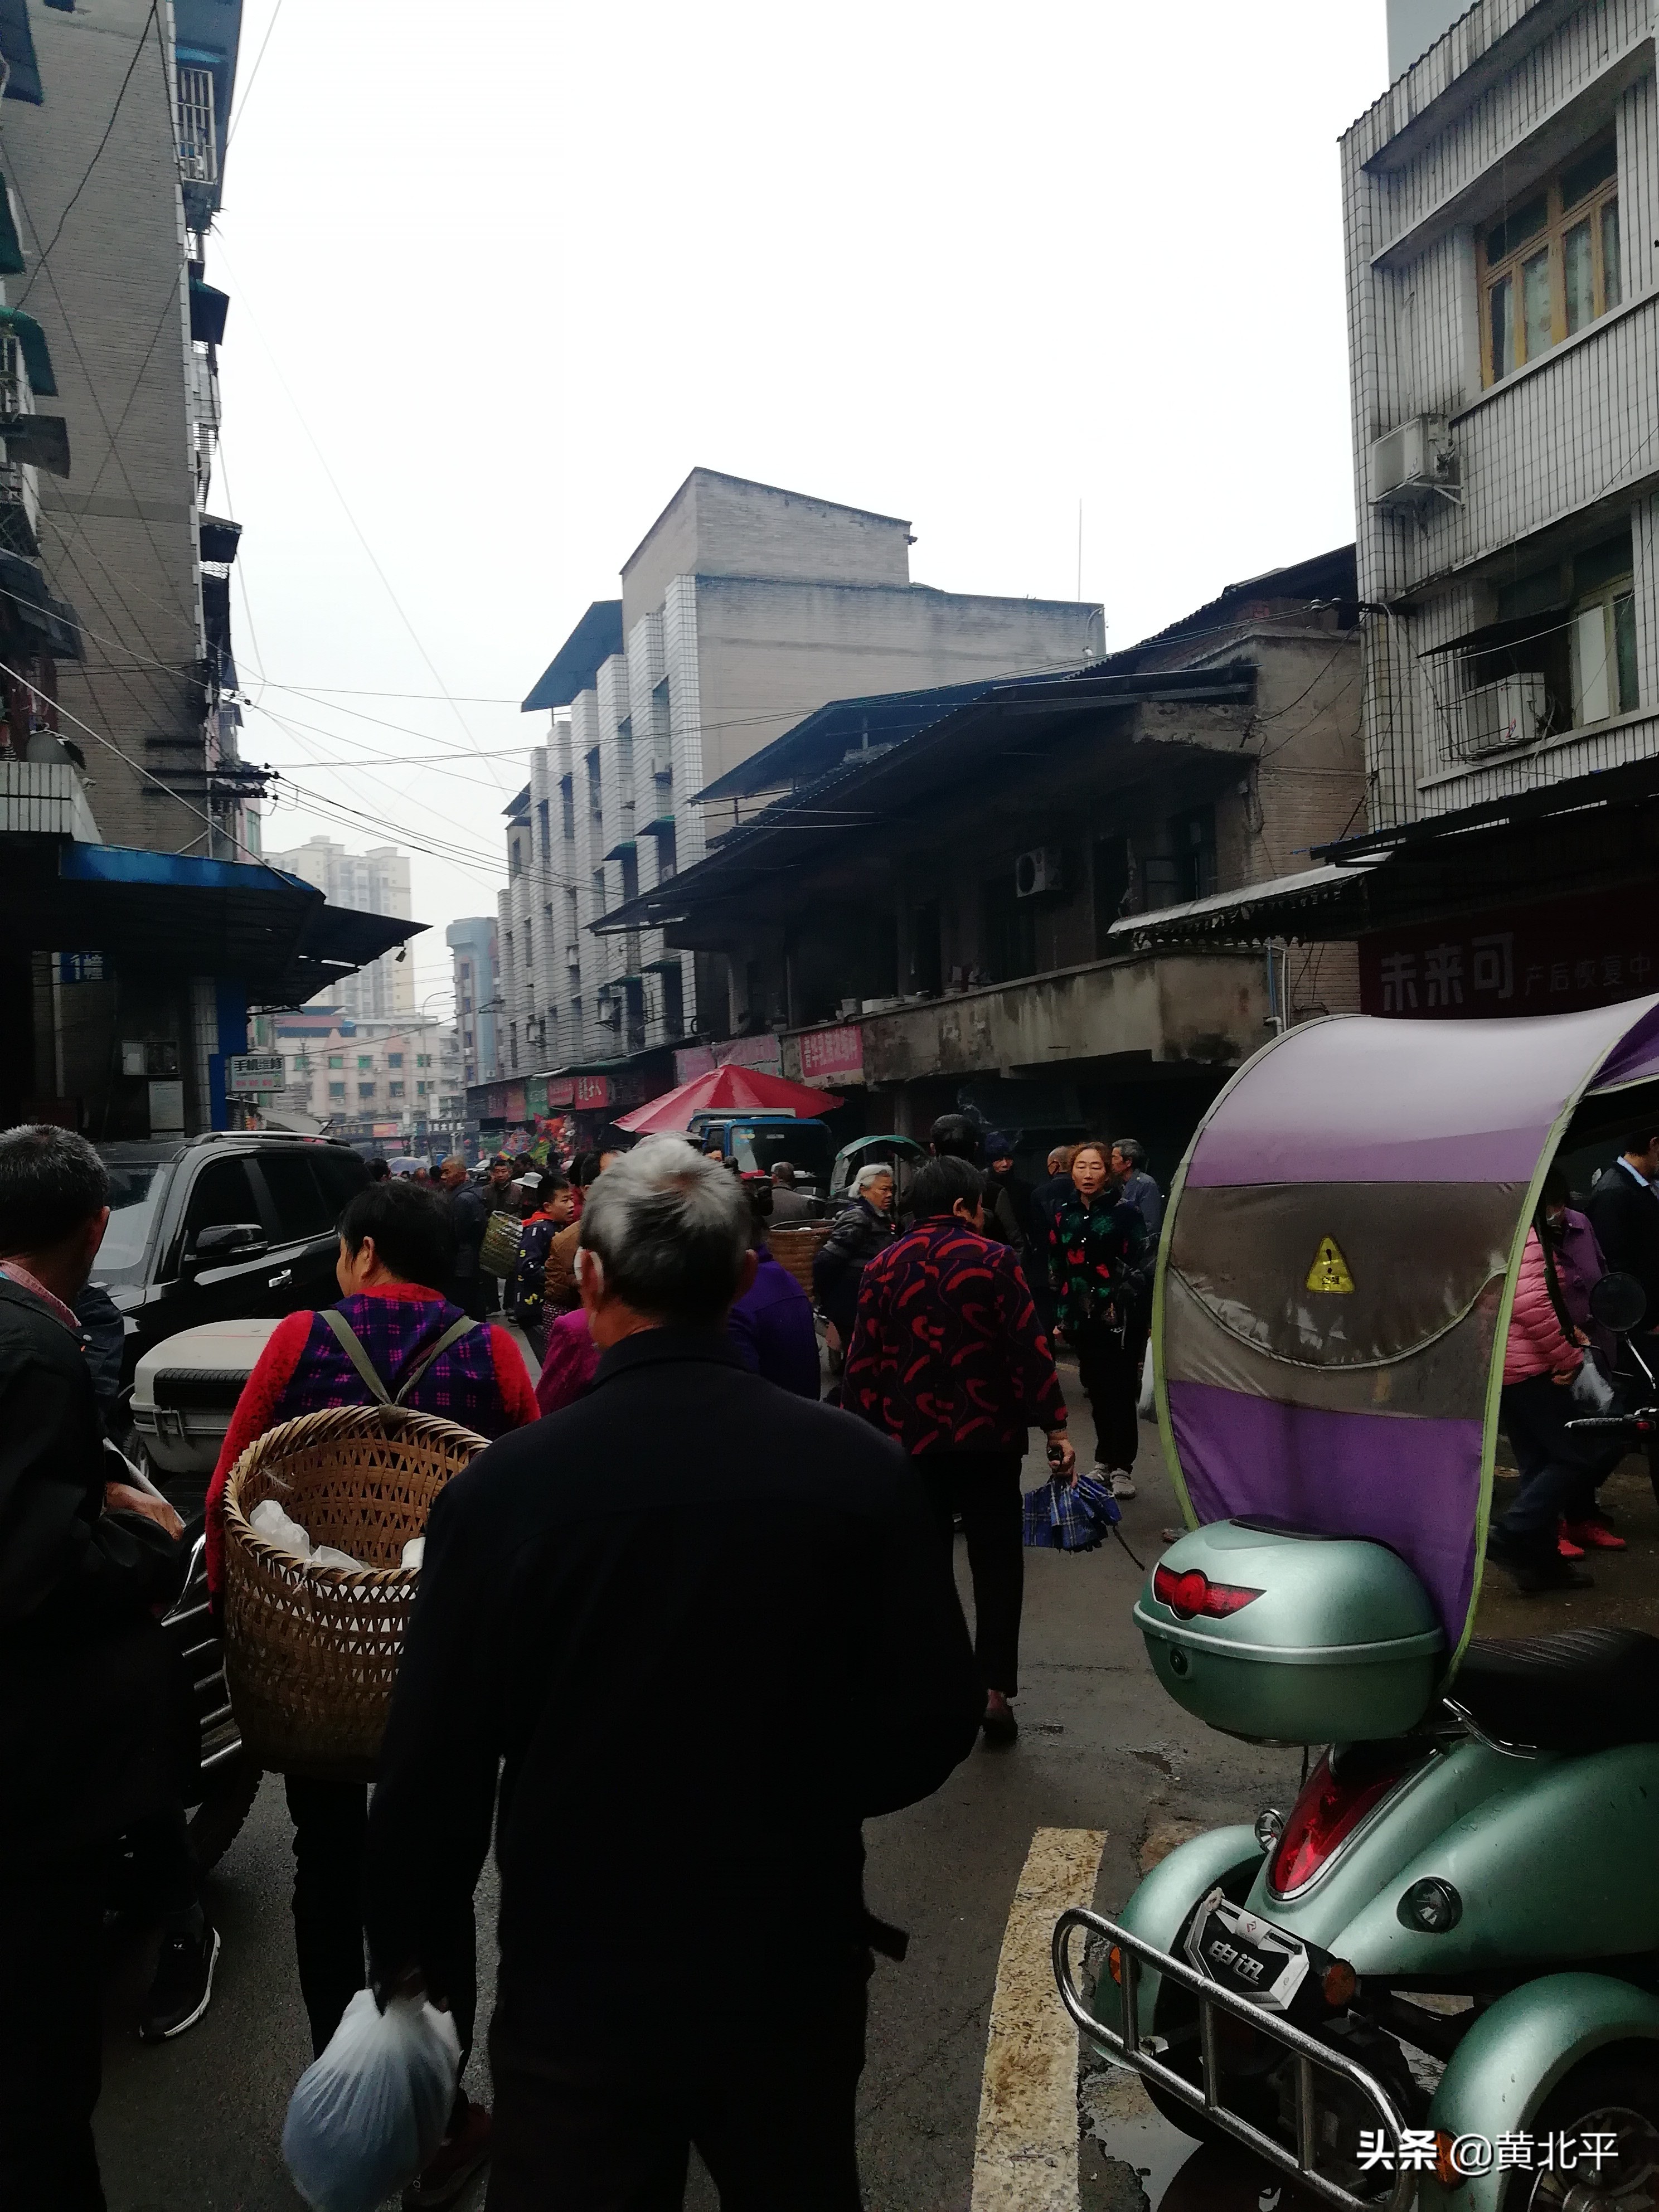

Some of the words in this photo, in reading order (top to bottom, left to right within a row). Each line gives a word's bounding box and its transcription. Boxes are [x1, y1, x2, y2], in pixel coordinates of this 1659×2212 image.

[1381, 932, 1514, 1012] 未来可
[1525, 953, 1651, 996] 产后恢复中
